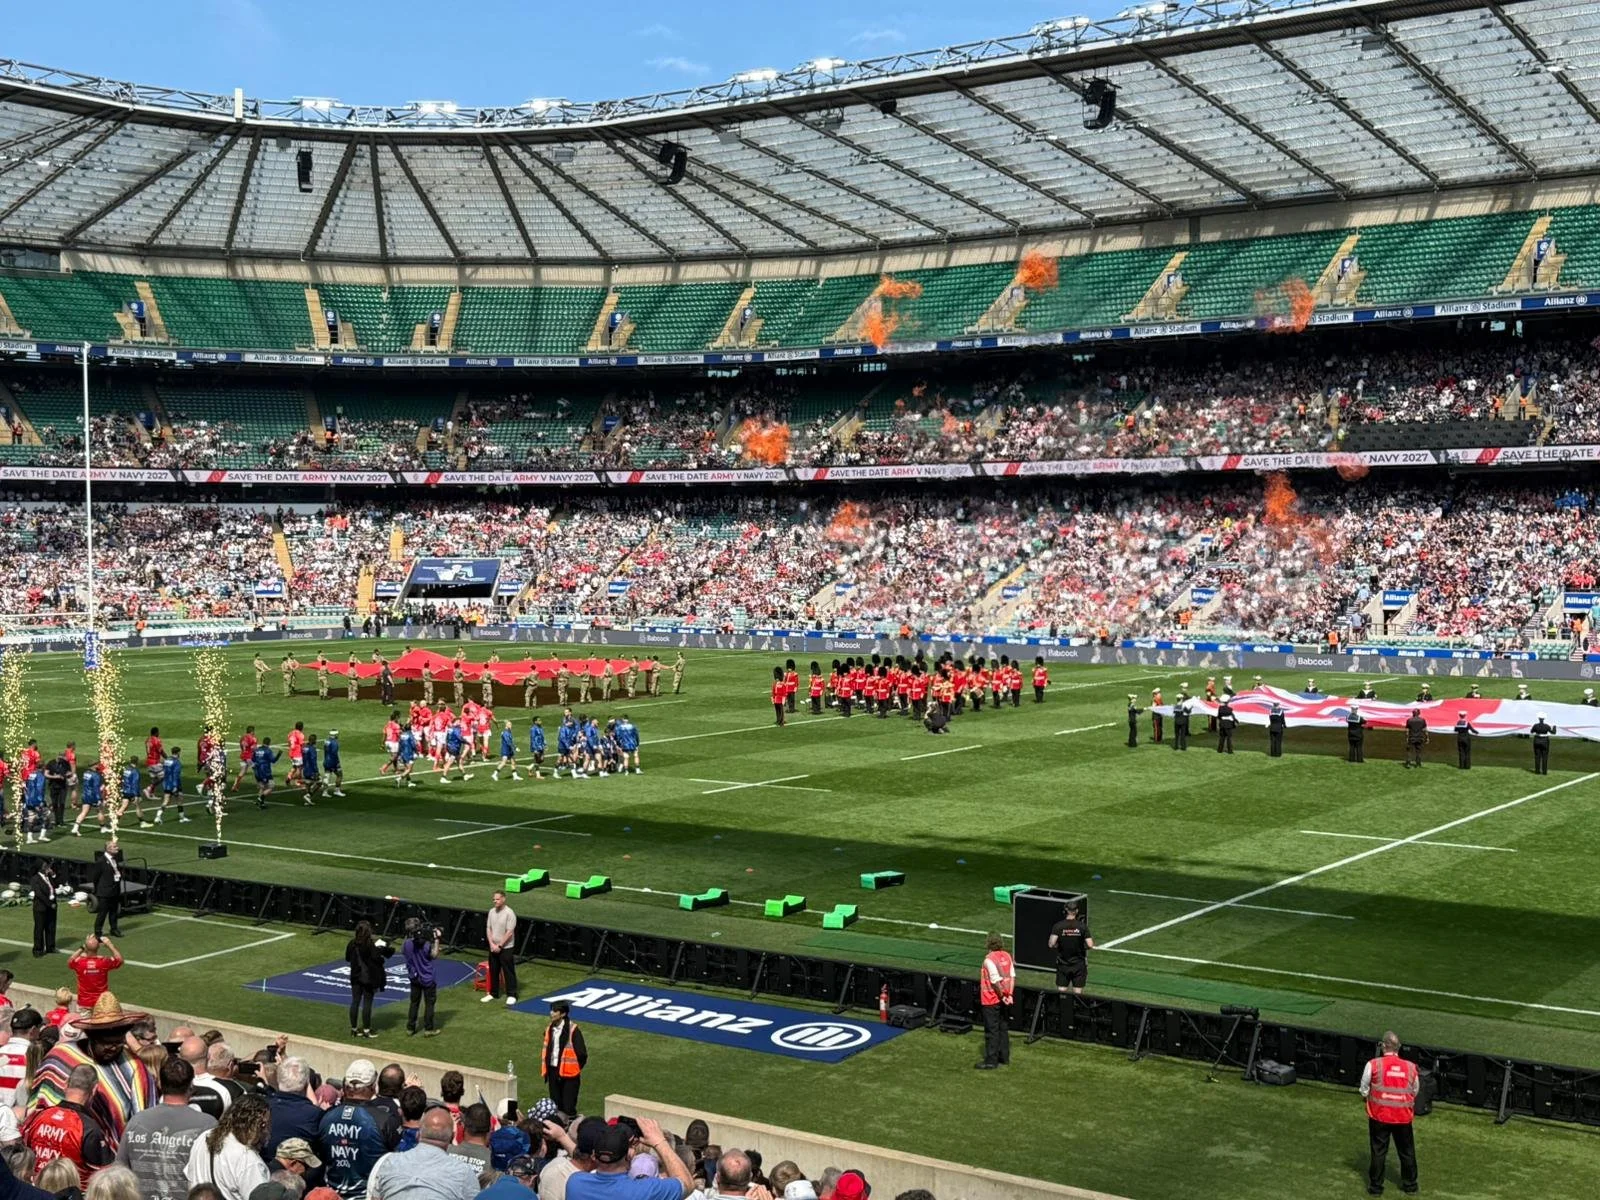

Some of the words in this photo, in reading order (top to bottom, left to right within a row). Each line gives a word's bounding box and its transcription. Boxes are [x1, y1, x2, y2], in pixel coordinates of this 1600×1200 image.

[1440, 304, 1469, 313] Allianz
[1482, 300, 1517, 310] Stadium
[1543, 297, 1575, 307] Allianz
[1317, 313, 1350, 321] Stadium
[1373, 309, 1402, 318] Allianz
[1134, 327, 1158, 335] Allianz
[1168, 325, 1198, 333] Stadium
[3, 342, 33, 350] Stadium
[951, 340, 973, 348] Allianz
[767, 352, 786, 360] Allianz
[794, 350, 817, 358] Stadium
[833, 348, 853, 356] Allianz
[1502, 450, 1532, 459] SAVE
[1533, 449, 1557, 458] THE
[1561, 448, 1593, 457] DATE
[1243, 458, 1269, 466] SAVE
[1272, 457, 1292, 465] THE
[1295, 456, 1321, 465] DATE
[1368, 453, 1399, 463] NAVY
[1402, 453, 1428, 462] 2027
[147, 472, 168, 480] 2027
[646, 472, 667, 480] SAVE
[669, 472, 686, 480] THE
[687, 472, 708, 480] DATE
[710, 472, 735, 480] ARMY
[736, 471, 743, 479] V
[743, 471, 763, 479] NAVY
[830, 469, 850, 477] SAVE
[869, 468, 889, 476] DATE
[891, 467, 917, 475] ARMY
[918, 467, 924, 475] V
[275, 473, 299, 481] DATE
[302, 473, 328, 481] ARMY
[330, 473, 338, 481] V
[340, 473, 365, 481] NAVY
[367, 473, 388, 481] 2027
[444, 473, 466, 481] SAVE
[468, 473, 486, 481] THE
[513, 473, 539, 481] ARMY
[540, 473, 547, 481] V
[549, 473, 573, 481] NAVY
[575, 473, 594, 481] 2027
[1385, 593, 1408, 602] Allianz
[1566, 596, 1591, 605] Allianz
[646, 635, 670, 643] Babcock
[1048, 649, 1079, 657] Babcock
[1298, 657, 1333, 666] Babcock
[541, 986, 774, 1035] Allianz
[36, 1123, 68, 1143] ARMY
[328, 1122, 363, 1140] ARMY
[126, 1130, 147, 1144] Los
[35, 1145, 61, 1159] NAVY
[331, 1144, 360, 1161] NAVY
[468, 1157, 486, 1166] STOP
